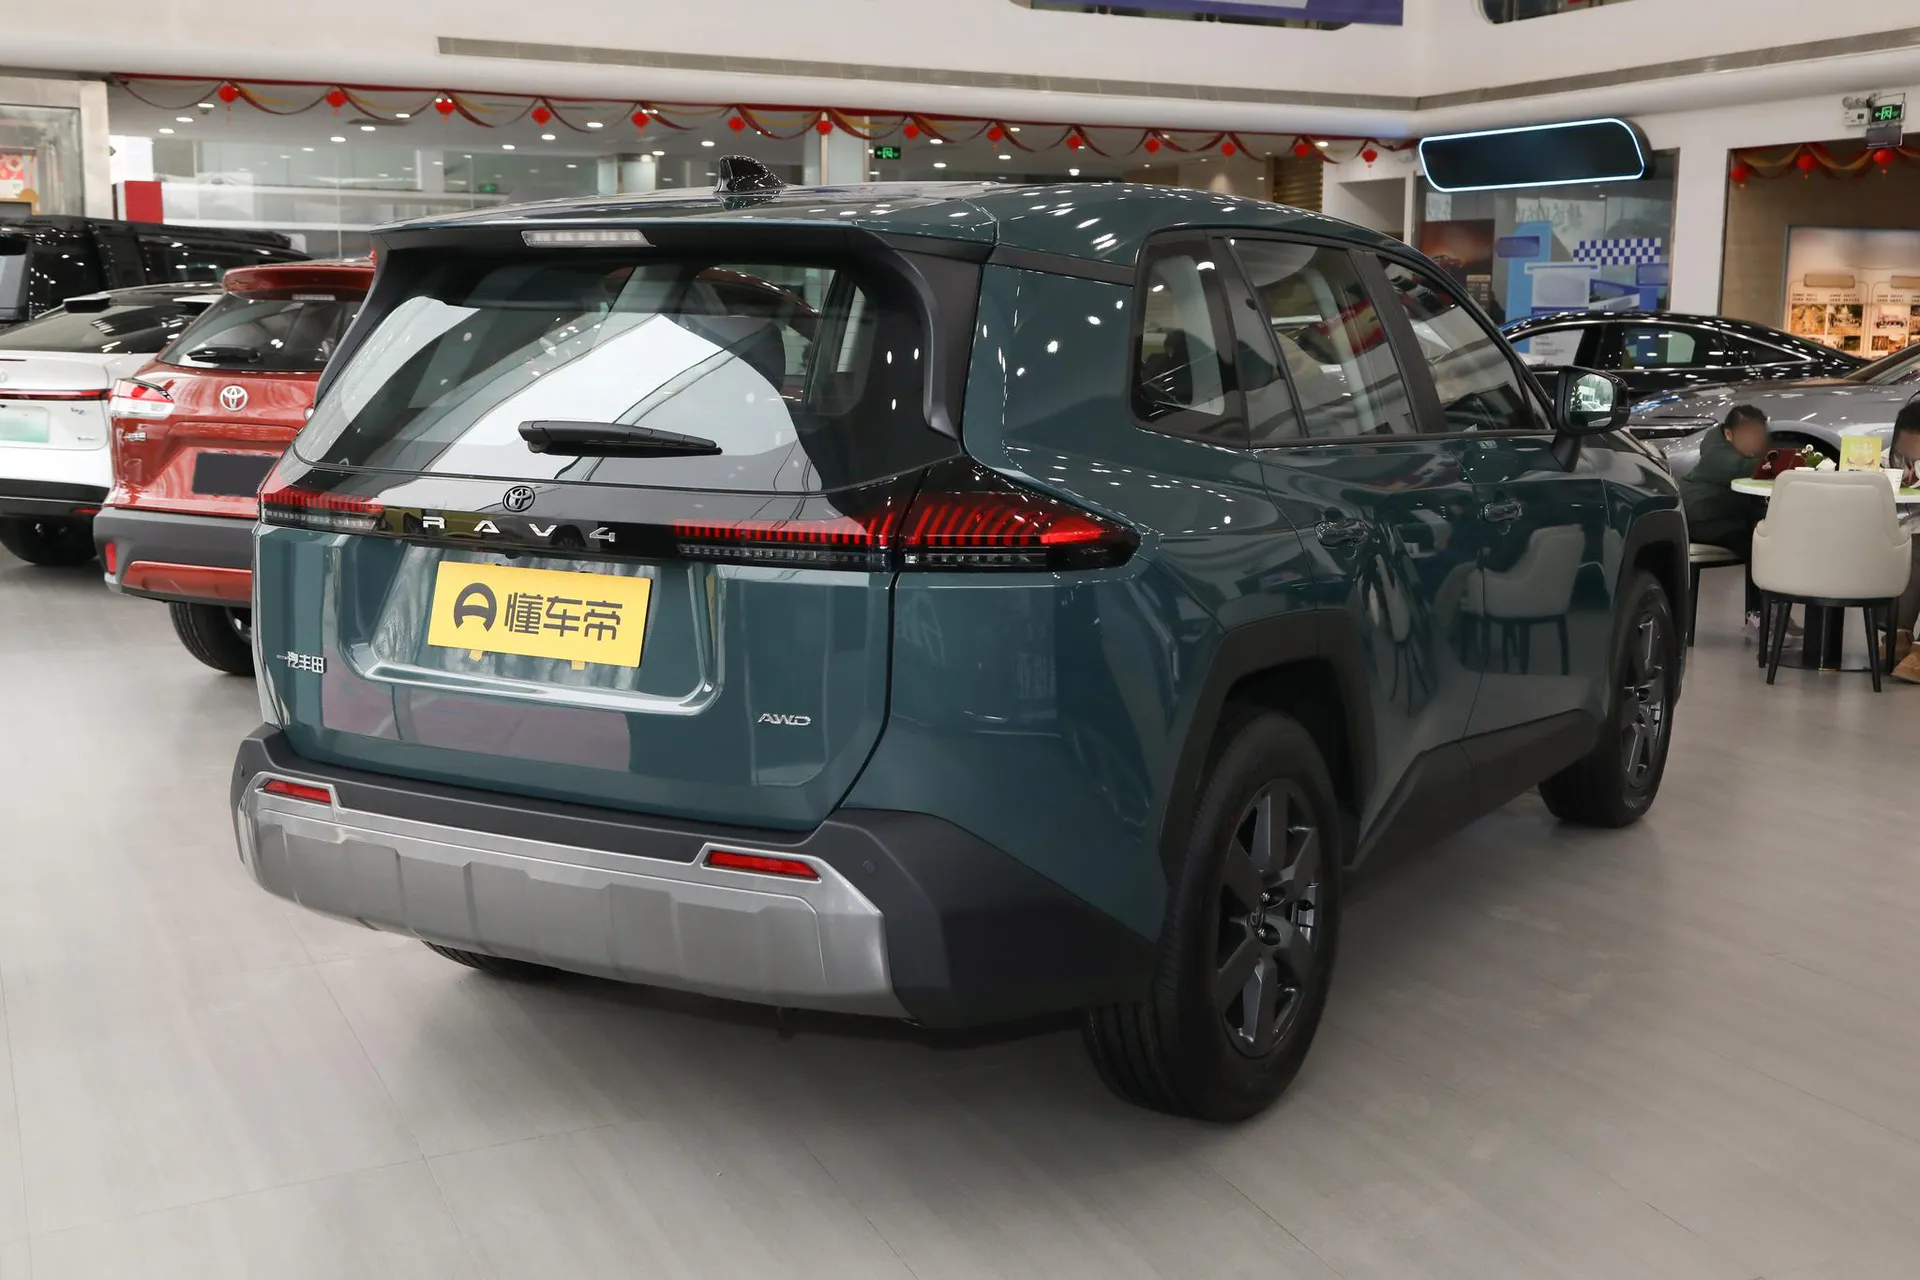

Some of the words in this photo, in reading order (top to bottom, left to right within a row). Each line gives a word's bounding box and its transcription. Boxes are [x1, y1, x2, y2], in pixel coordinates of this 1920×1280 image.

[422, 515, 616, 543] RAV4
[504, 591, 623, 642] 懂车帝
[276, 651, 325, 674] 一汽丰田
[757, 712, 812, 726] AWD
